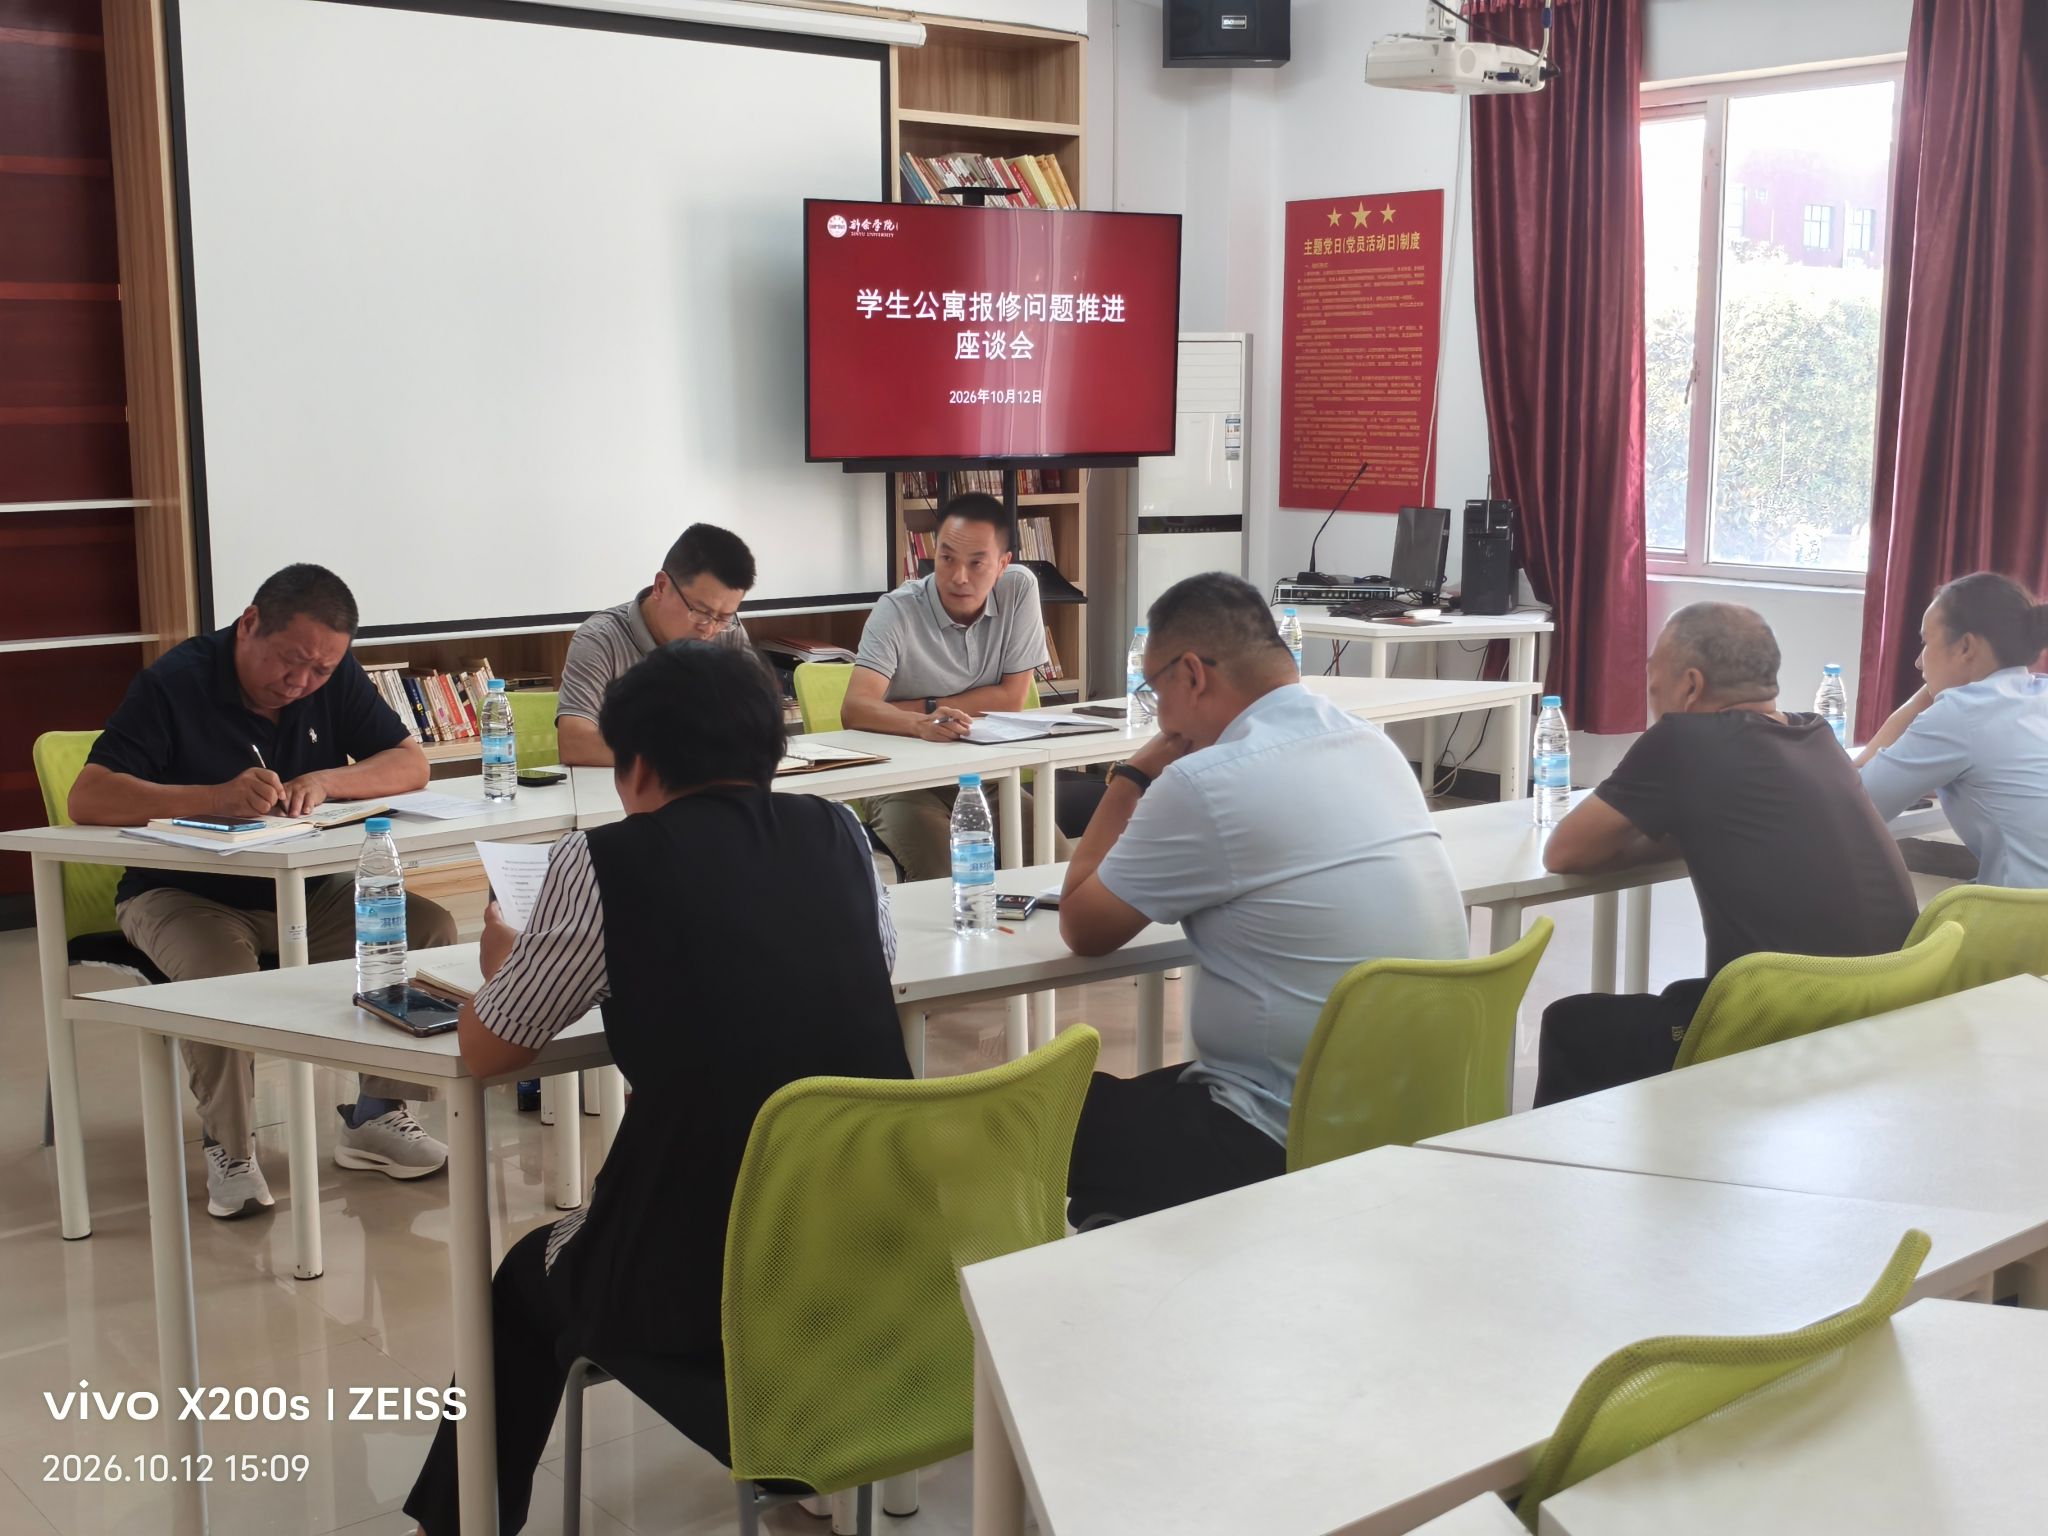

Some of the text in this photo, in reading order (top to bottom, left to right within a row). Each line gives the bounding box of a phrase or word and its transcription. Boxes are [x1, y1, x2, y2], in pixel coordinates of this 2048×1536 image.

[1304, 232, 1420, 255] 主题党日(党员活动日)制度
[856, 289, 1126, 324] 学生公寓报修问题推进
[954, 330, 1034, 361] 座谈会
[949, 388, 1043, 405] 2026年10月12日
